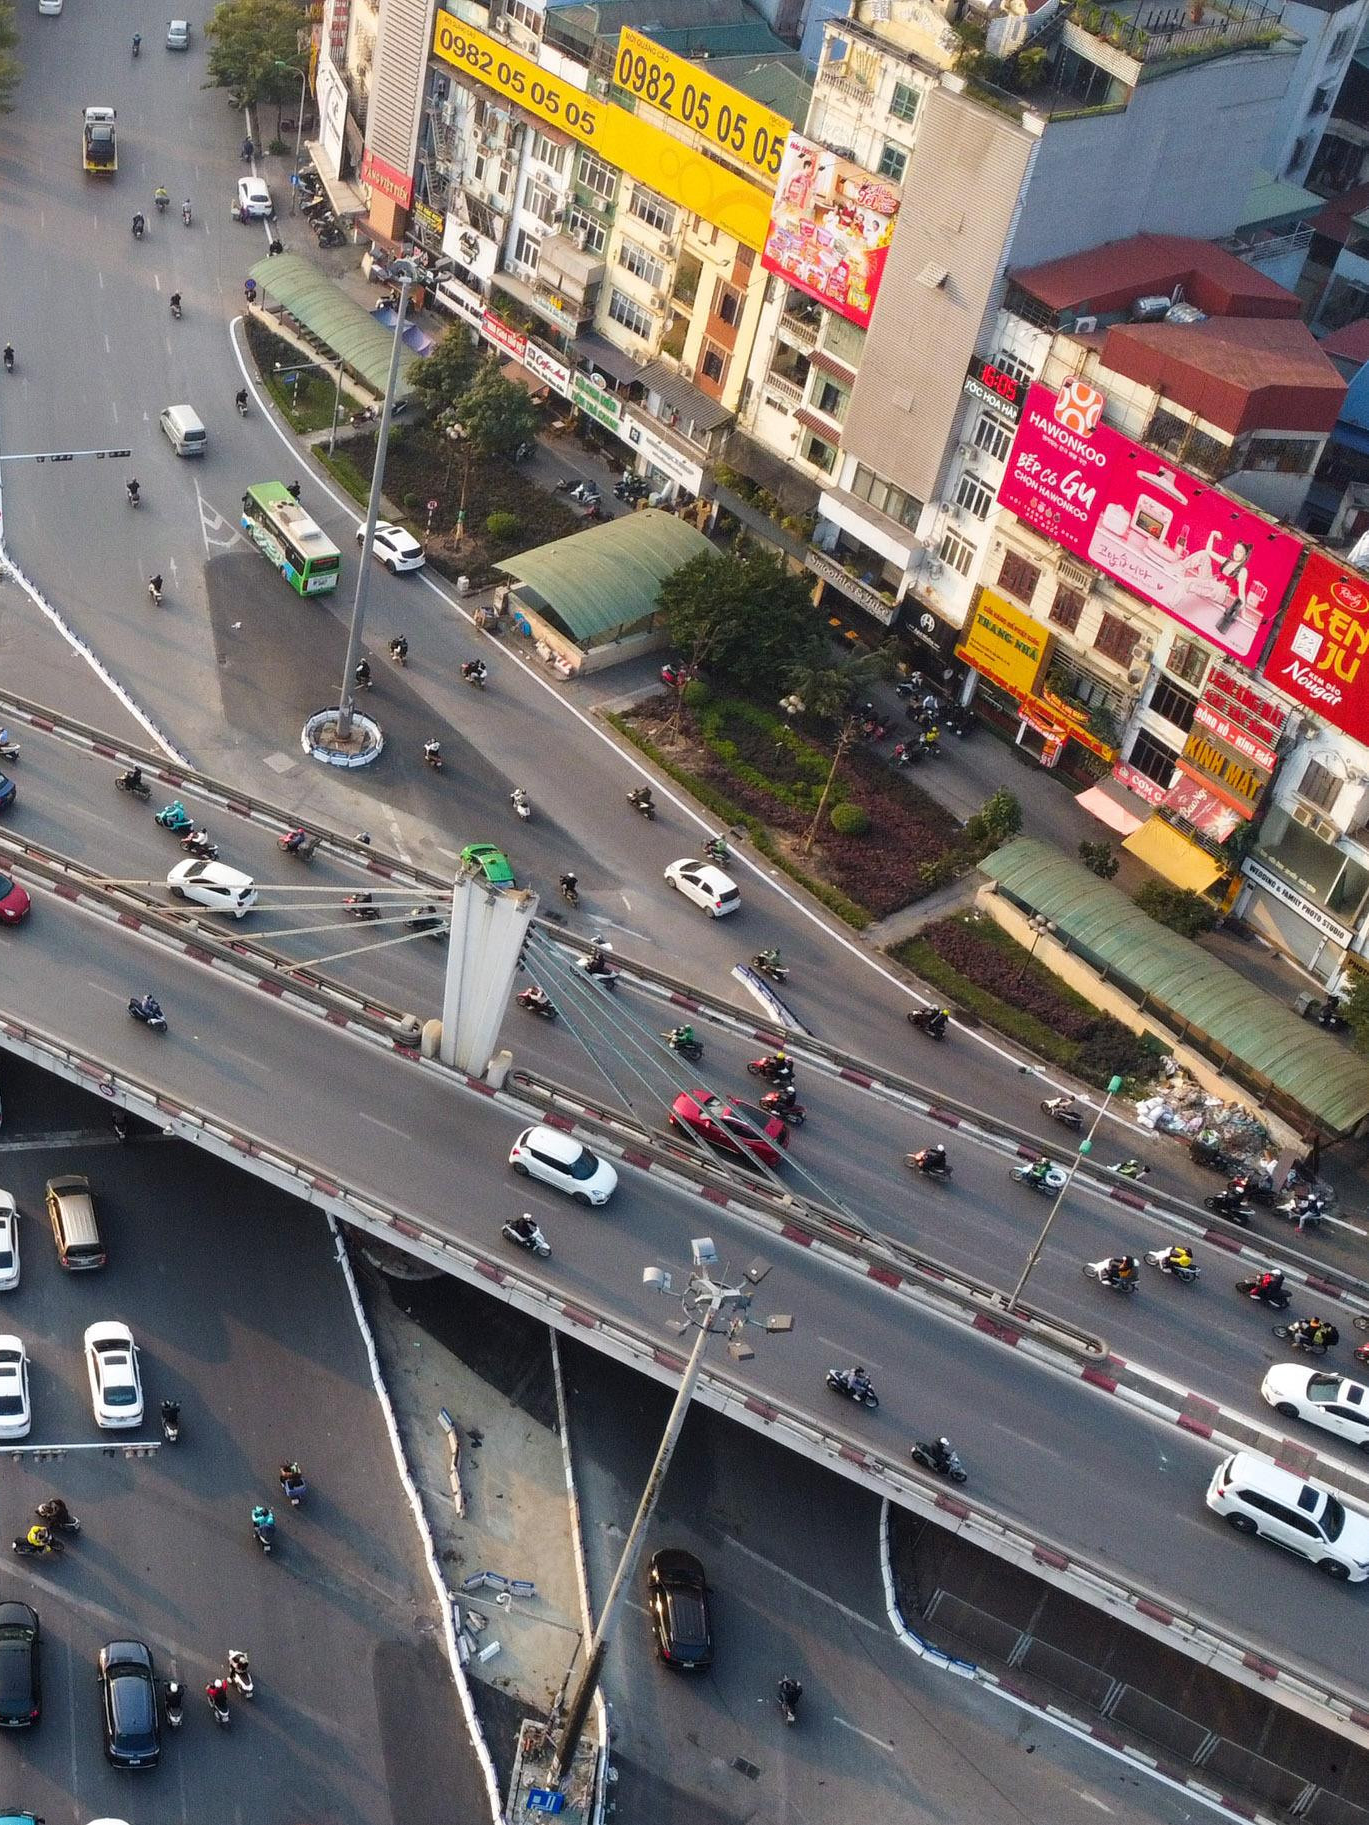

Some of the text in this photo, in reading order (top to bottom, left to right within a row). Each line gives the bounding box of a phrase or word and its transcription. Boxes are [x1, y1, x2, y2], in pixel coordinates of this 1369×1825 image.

[440, 28, 493, 76] 0982
[497, 62, 525, 94] 05
[531, 82, 560, 114] 05
[565, 102, 596, 135] 05
[619, 48, 784, 174] 0982 05 05 05
[983, 392, 1001, 409] HOA
[1029, 411, 1106, 467] HAWONKOO
[1016, 452, 1041, 475] BẾP
[1014, 470, 1088, 522] CHỌN HAWONKOO
[854, 587, 864, 600] &
[977, 613, 1013, 645] TRANG
[1303, 594, 1369, 655] KEN
[1281, 660, 1343, 706] Nougat
[1309, 671, 1324, 685] KEM
[1317, 641, 1361, 683] JU
[1183, 735, 1261, 800] KÍNH MẮT
[1249, 864, 1276, 888] WEDDING
[1281, 888, 1302, 908] FAMILY
[1301, 903, 1322, 923] PHOTO
[1321, 919, 1345, 940] STUDIO
[1348, 959, 1369, 977] PHOT
